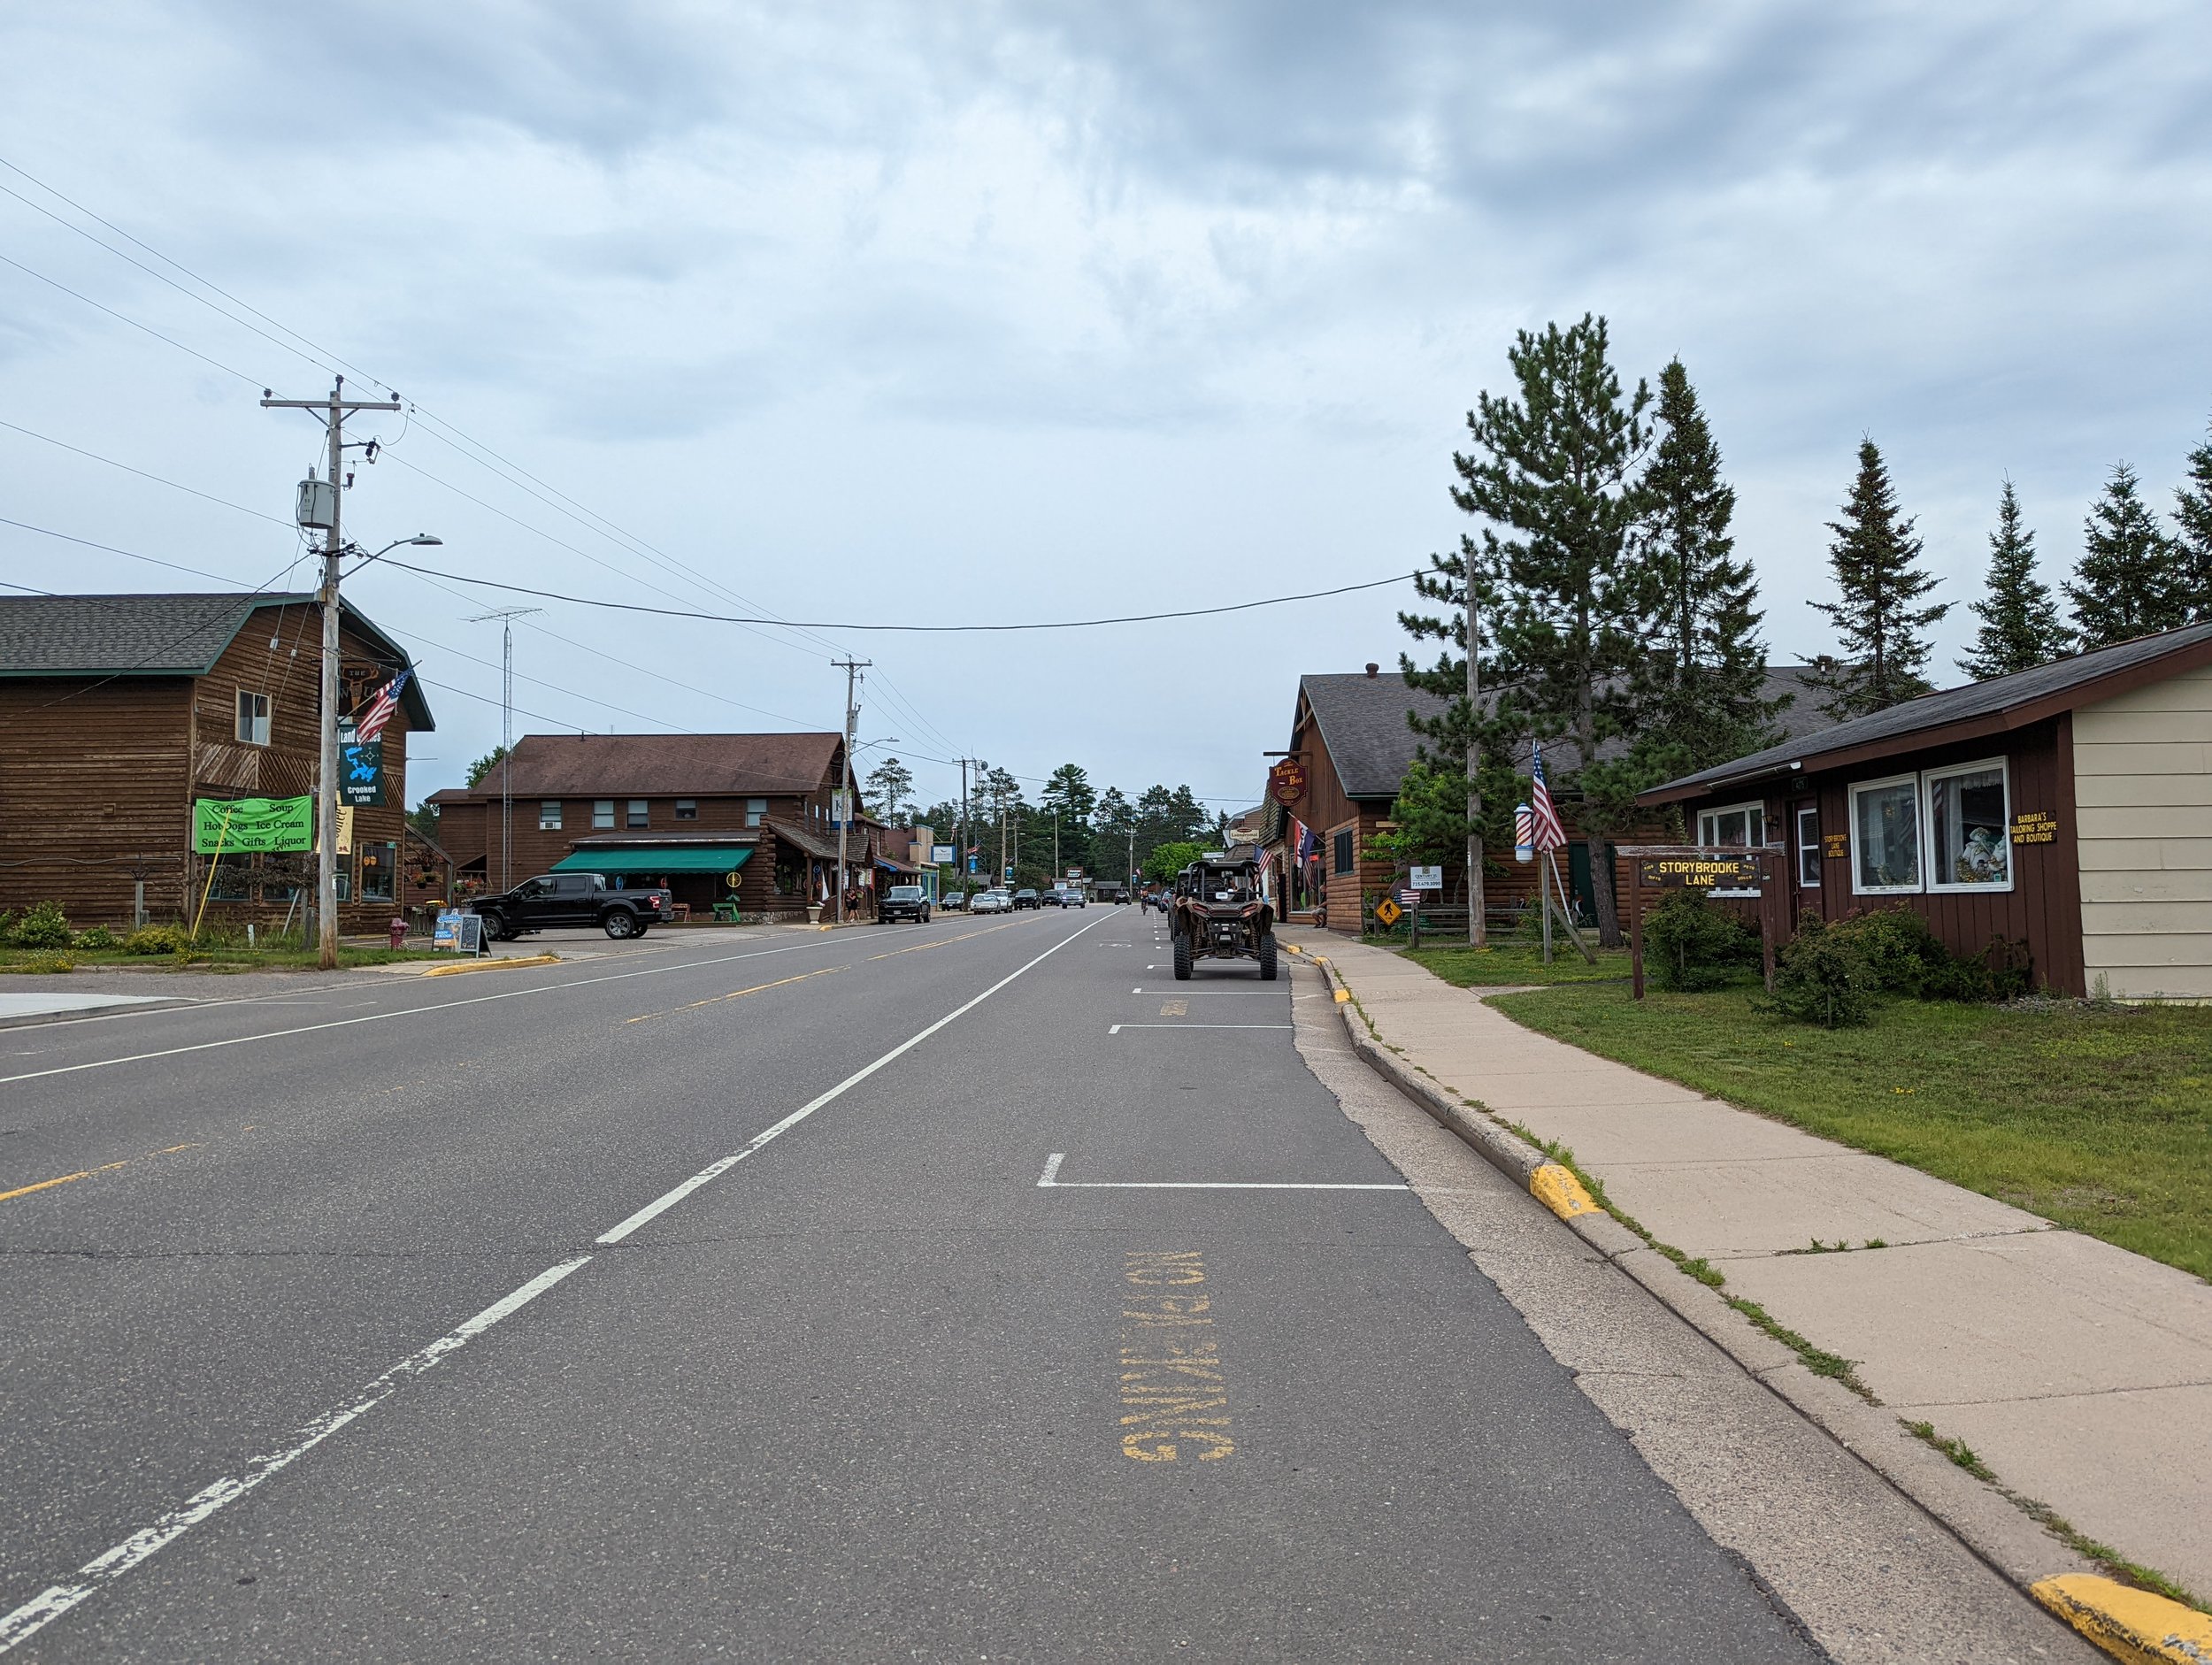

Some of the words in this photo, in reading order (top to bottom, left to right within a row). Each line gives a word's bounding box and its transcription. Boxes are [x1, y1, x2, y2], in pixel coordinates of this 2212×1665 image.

[341, 728, 356, 743] Land
[347, 785, 376, 794] Crooked
[355, 794, 371, 803] Lake
[212, 804, 243, 814] Coffee
[269, 803, 294, 814] Soup
[2017, 811, 2047, 824] BARBARA'S
[204, 821, 222, 831] Hot
[225, 821, 248, 832] Dogs
[256, 820, 272, 830] Ice
[273, 819, 304, 830] Cream
[2010, 824, 2035, 834] TAILORING
[2037, 821, 2057, 832] SHOPPE
[202, 837, 234, 848] Snacks
[242, 836, 266, 847] Gifts
[274, 836, 307, 847] Liquor
[1824, 833, 1847, 843] STORYBROOKE
[2026, 832, 2053, 843] BOUTIQUE
[1659, 862, 1740, 873] STORYBROOKE
[1686, 874, 1715, 886] LANE
